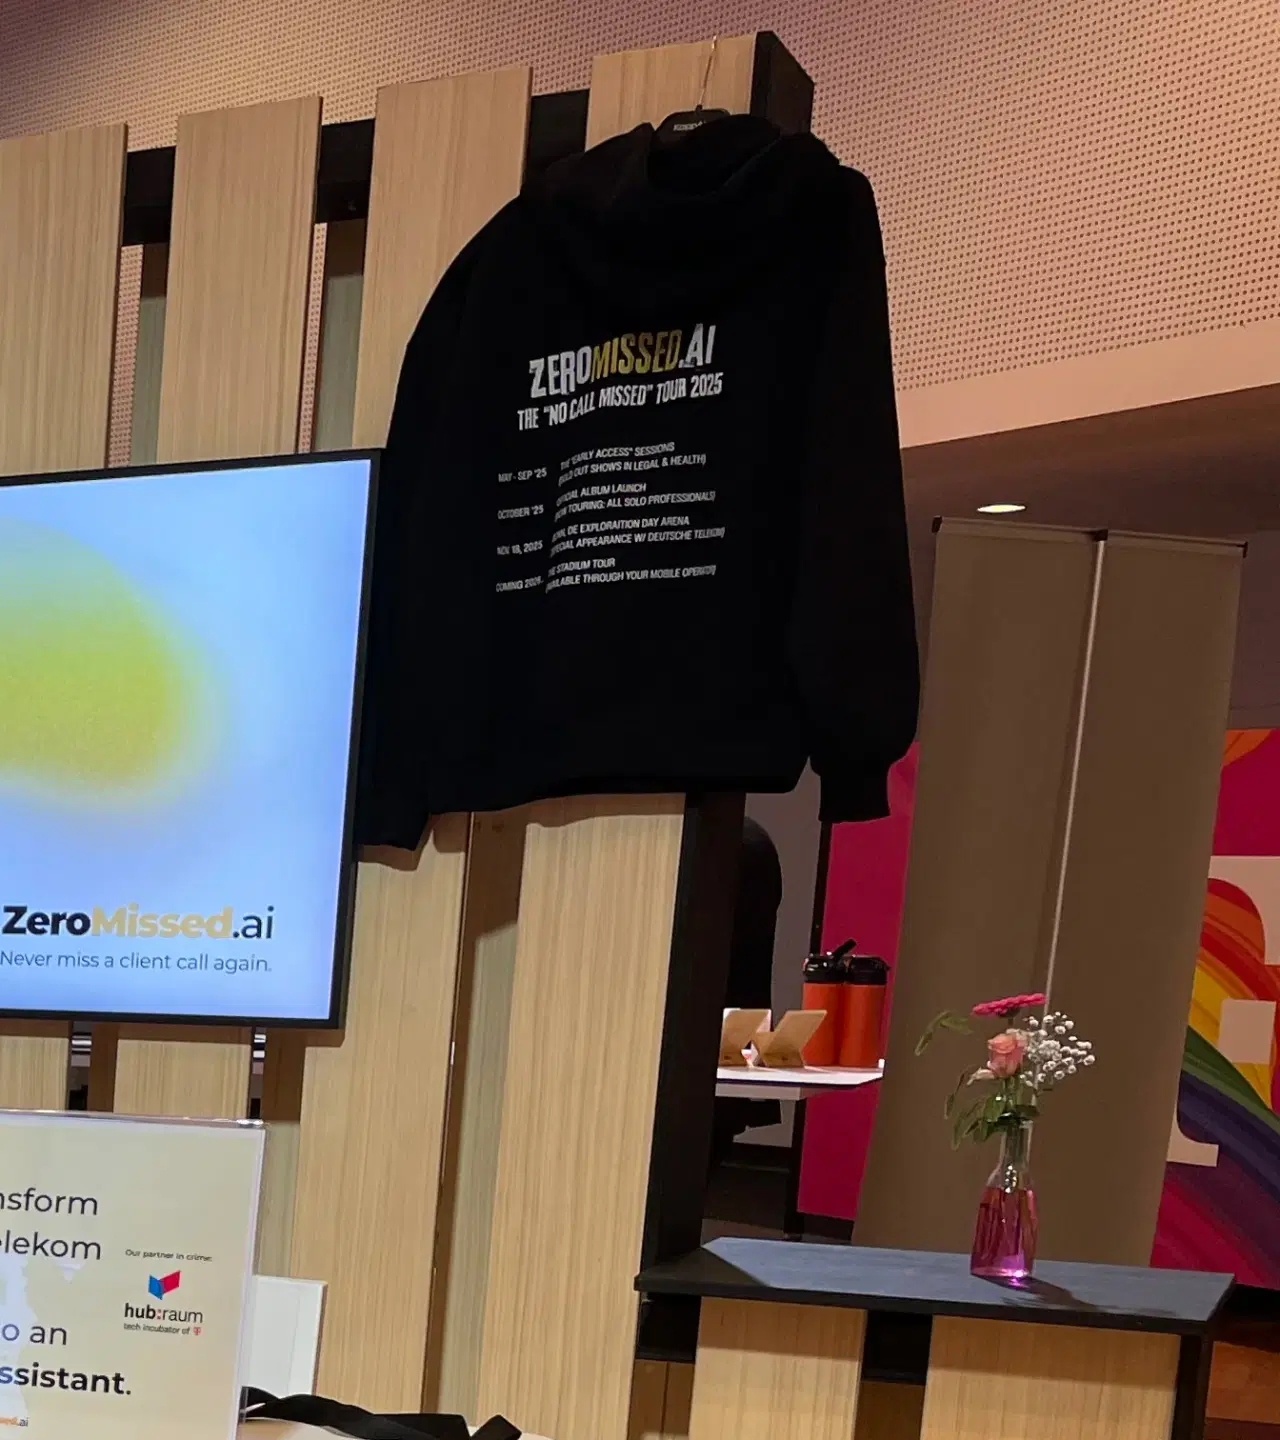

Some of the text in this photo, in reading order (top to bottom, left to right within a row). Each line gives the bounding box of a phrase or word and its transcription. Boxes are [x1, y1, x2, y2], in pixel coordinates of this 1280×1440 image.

[529, 323, 716, 398] ZEROMISSED.AI
[517, 371, 724, 431] THE "NO CALL MISSED" TOUR 2025
[635, 441, 675, 456] SESSIONS
[590, 461, 622, 473] SHOWS
[623, 461, 633, 471] IN
[633, 458, 661, 471] LEGAL
[661, 457, 668, 467] &
[518, 470, 533, 481] SEP
[580, 484, 610, 497] ALBUM
[612, 482, 647, 494] LAUNCH
[606, 498, 622, 508] ALL
[624, 495, 647, 507] SOLO
[497, 507, 530, 520] OCTOBER
[642, 517, 659, 529] DAY
[661, 516, 689, 527] ARENA
[576, 533, 632, 548] APPEARANCE
[647, 529, 692, 542] DEUTSCHE
[556, 560, 591, 574] STADIUM
[592, 558, 616, 568] TOUR
[583, 572, 625, 583] THROUGH
[626, 570, 649, 580] YOUR
[650, 568, 681, 579] MOBILE
[1, 902, 275, 939] ZeroMissed.ai
[0, 950, 273, 975] Never miss a client call again.
[125, 1249, 141, 1257] Our
[143, 1251, 174, 1259] partner
[124, 1302, 203, 1324] hub:raum
[29, 1324, 68, 1346] an
[123, 1322, 141, 1330] tech
[143, 1324, 180, 1334] incubator
